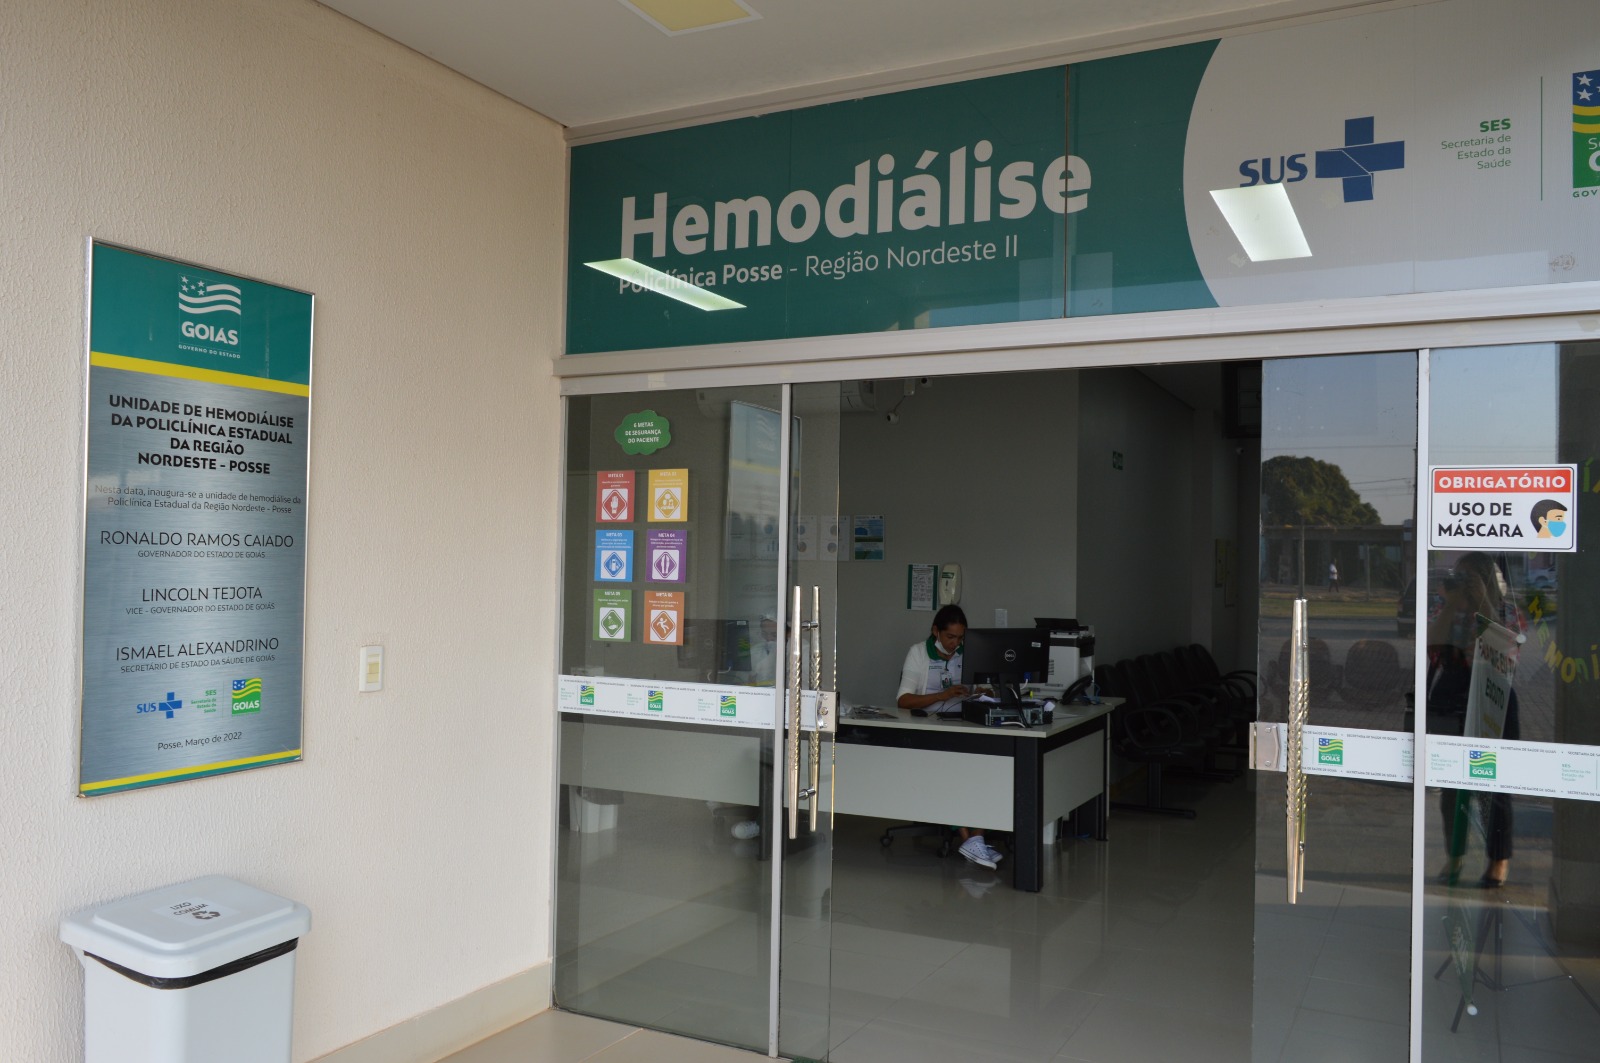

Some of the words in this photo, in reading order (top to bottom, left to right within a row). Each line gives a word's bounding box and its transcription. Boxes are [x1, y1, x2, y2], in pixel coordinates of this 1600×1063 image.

[1480, 118, 1511, 132] SES
[1442, 136, 1494, 150] Secretaria
[1497, 134, 1512, 143] de
[1458, 148, 1494, 160] Estado
[1498, 146, 1511, 154] da
[1239, 154, 1308, 188] SUS
[1478, 158, 1512, 170] Saúde
[621, 140, 1091, 260] Hemodiálise
[723, 263, 782, 284] Posse
[806, 250, 878, 280] Região
[887, 240, 996, 269] Nordeste
[1006, 235, 1018, 258] II
[178, 344, 208, 353] GOVERNO
[109, 394, 180, 414] UNIDADE
[184, 404, 202, 417] DE
[206, 407, 294, 428] HEMODIÁLISE
[111, 414, 133, 428] DA
[136, 416, 226, 437] POLICLÍNICA
[229, 427, 292, 444] ESTADUAL
[170, 438, 192, 450] DA
[193, 439, 244, 456] REGIÃO
[138, 453, 217, 470] NORDESTE
[230, 460, 271, 474] POSSE
[1438, 473, 1566, 488] OBRIGATÓRIO
[95, 485, 122, 494] Nesta
[124, 486, 146, 496] data,
[148, 488, 197, 498] inaugura-se
[206, 492, 236, 500] unidade
[238, 493, 248, 501] de
[250, 494, 292, 504] hemodiálise
[292, 496, 302, 504] da
[108, 496, 152, 508] Policlínica
[154, 499, 190, 508] Estadual
[192, 501, 202, 510] da
[204, 501, 230, 512] Região
[232, 504, 266, 512] Nordeste
[272, 505, 292, 514] Posse
[1449, 502, 1485, 516] USO
[1490, 502, 1512, 516] DE
[1438, 520, 1524, 538] MÁSCARA
[100, 530, 182, 546] RONALDO
[187, 532, 240, 547] RAMOS
[244, 534, 294, 548] CAIADO
[138, 550, 192, 558] GOVERNADOR
[142, 587, 209, 602] LINCOLN
[213, 586, 262, 600] TEJOTA
[150, 605, 204, 614] GOVERNADOR
[218, 604, 244, 612] ESTADO
[245, 603, 254, 611] DE
[116, 644, 174, 661] ISMAEL
[177, 638, 279, 656] ALEXANDRINO
[120, 662, 168, 674] SECRETÁRIO
[170, 661, 180, 670] DE
[181, 659, 210, 669] ESTADO
[210, 658, 221, 666] DA
[246, 656, 255, 664] DE
[136, 702, 156, 714] SUS
[158, 741, 184, 750] Posse,
[186, 737, 210, 746] Março
[212, 734, 222, 742] de
[224, 732, 242, 742] 2022
